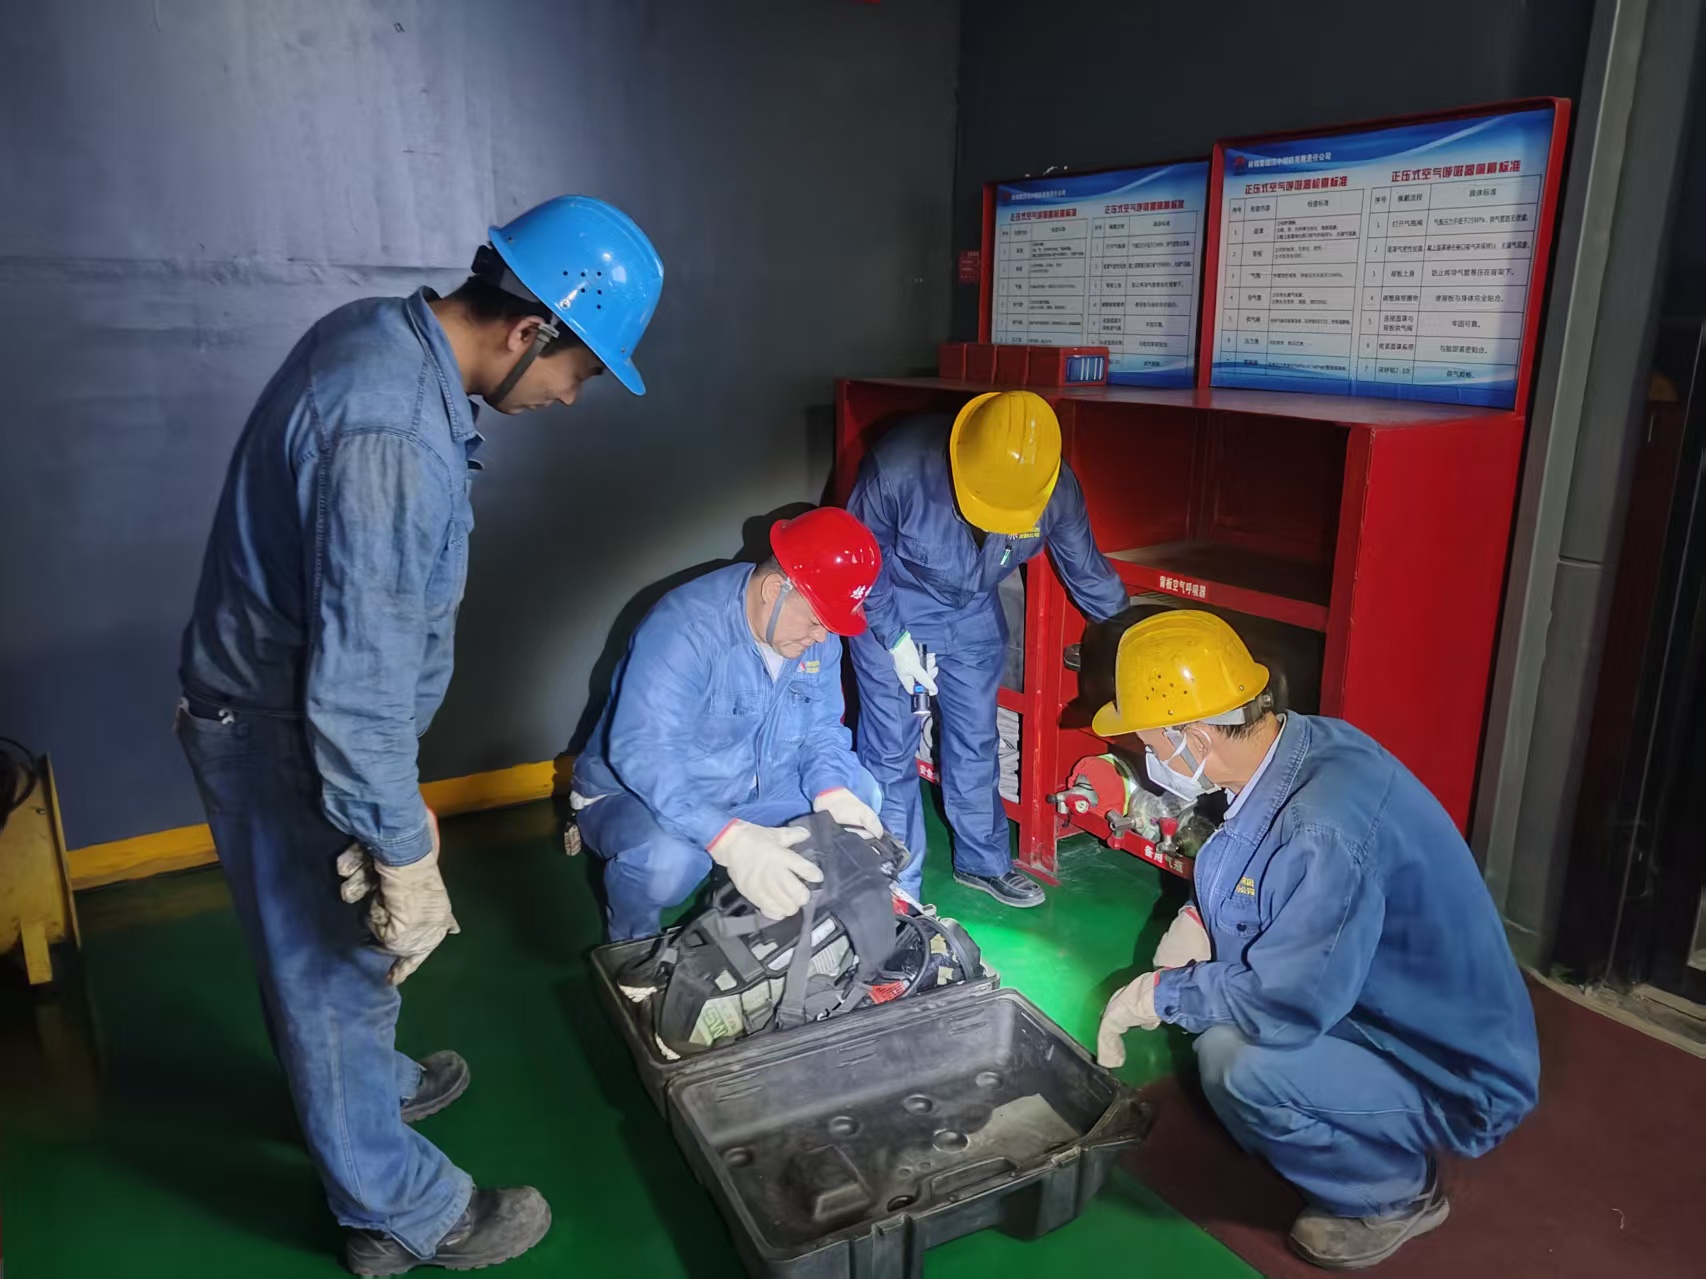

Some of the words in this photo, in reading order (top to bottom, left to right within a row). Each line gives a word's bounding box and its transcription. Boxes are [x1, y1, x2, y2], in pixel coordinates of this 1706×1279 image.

[1391, 159, 1522, 183] 正压式空气呼吸器佩戴标准
[1160, 575, 1207, 599] 背板空气呼吸器
